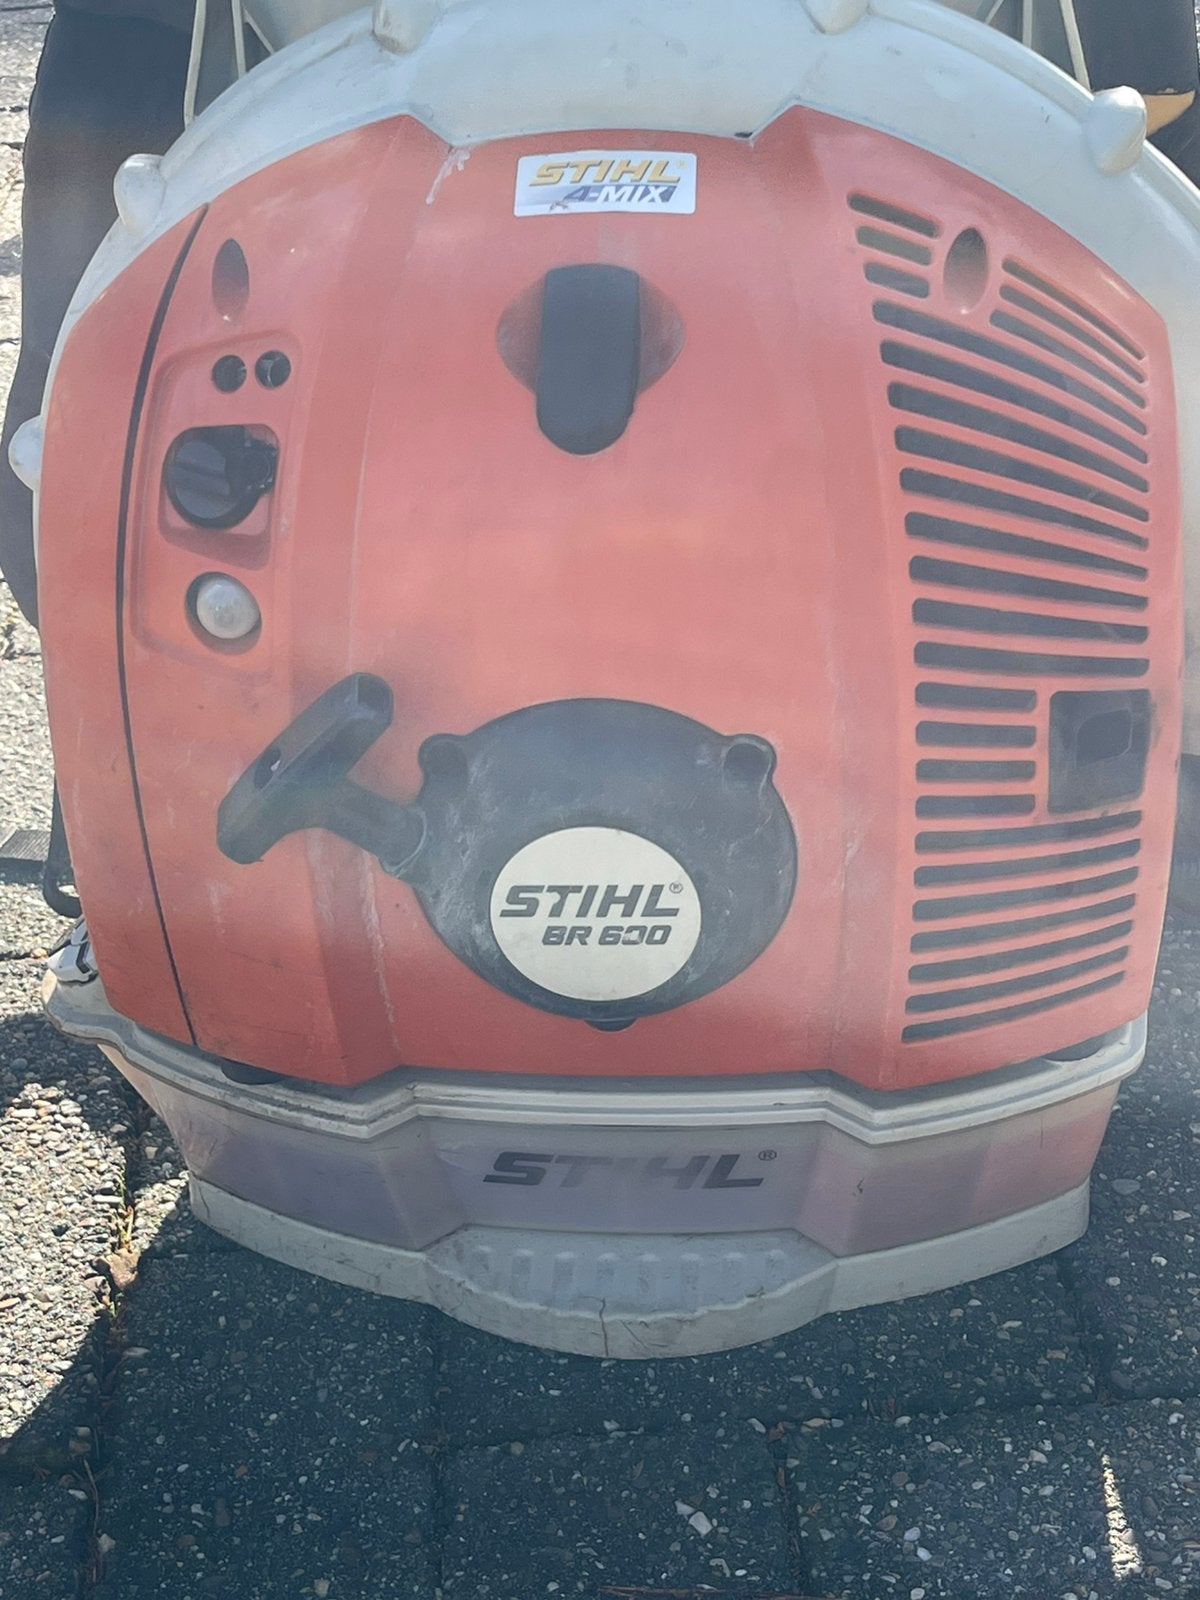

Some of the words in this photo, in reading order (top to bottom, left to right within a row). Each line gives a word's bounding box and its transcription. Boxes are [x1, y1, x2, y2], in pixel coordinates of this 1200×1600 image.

[529, 159, 681, 187] STIHL
[562, 184, 677, 203] 4-MIX
[499, 884, 680, 918] STIHL
[541, 925, 593, 946] BR
[598, 924, 672, 946] 600
[482, 1151, 764, 1190] STHL
